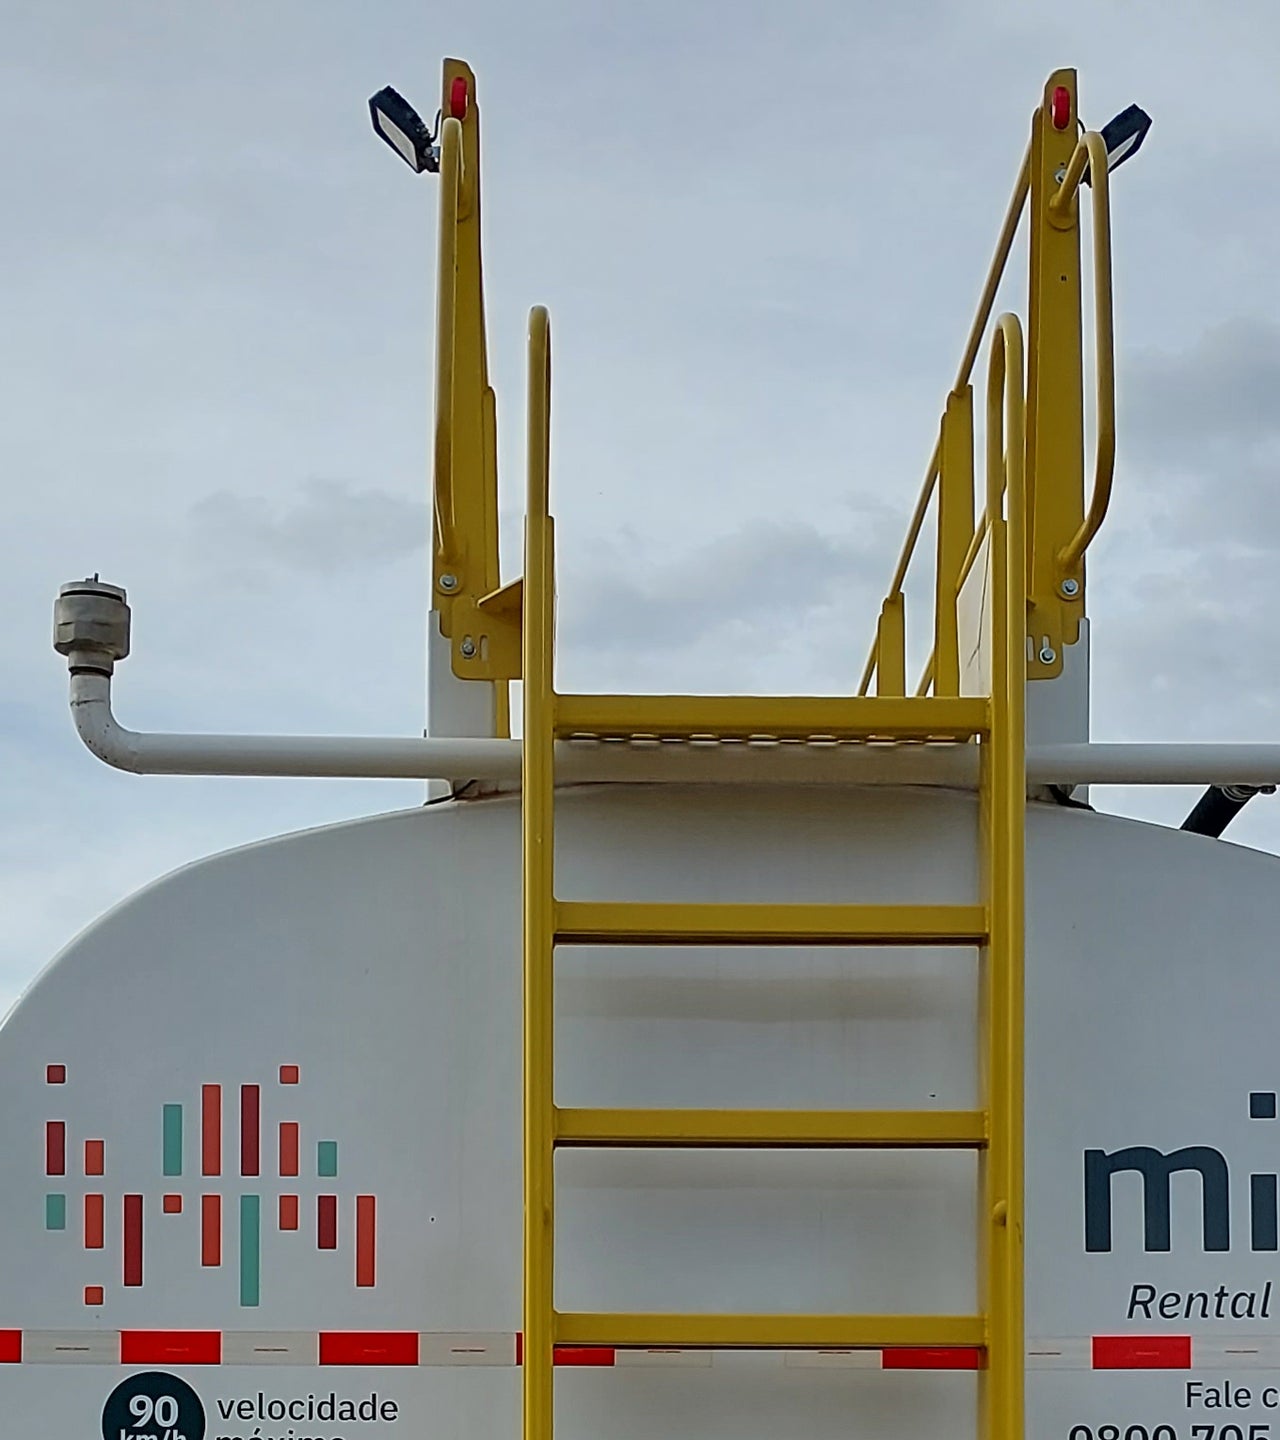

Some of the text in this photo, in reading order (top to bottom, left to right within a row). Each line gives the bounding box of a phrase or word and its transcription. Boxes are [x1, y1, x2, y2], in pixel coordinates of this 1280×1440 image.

[1126, 1283, 1271, 1320] Rental
[216, 1392, 399, 1422] velocidade
[1185, 1382, 1252, 1409] Fale
[129, 1395, 179, 1428] 90
